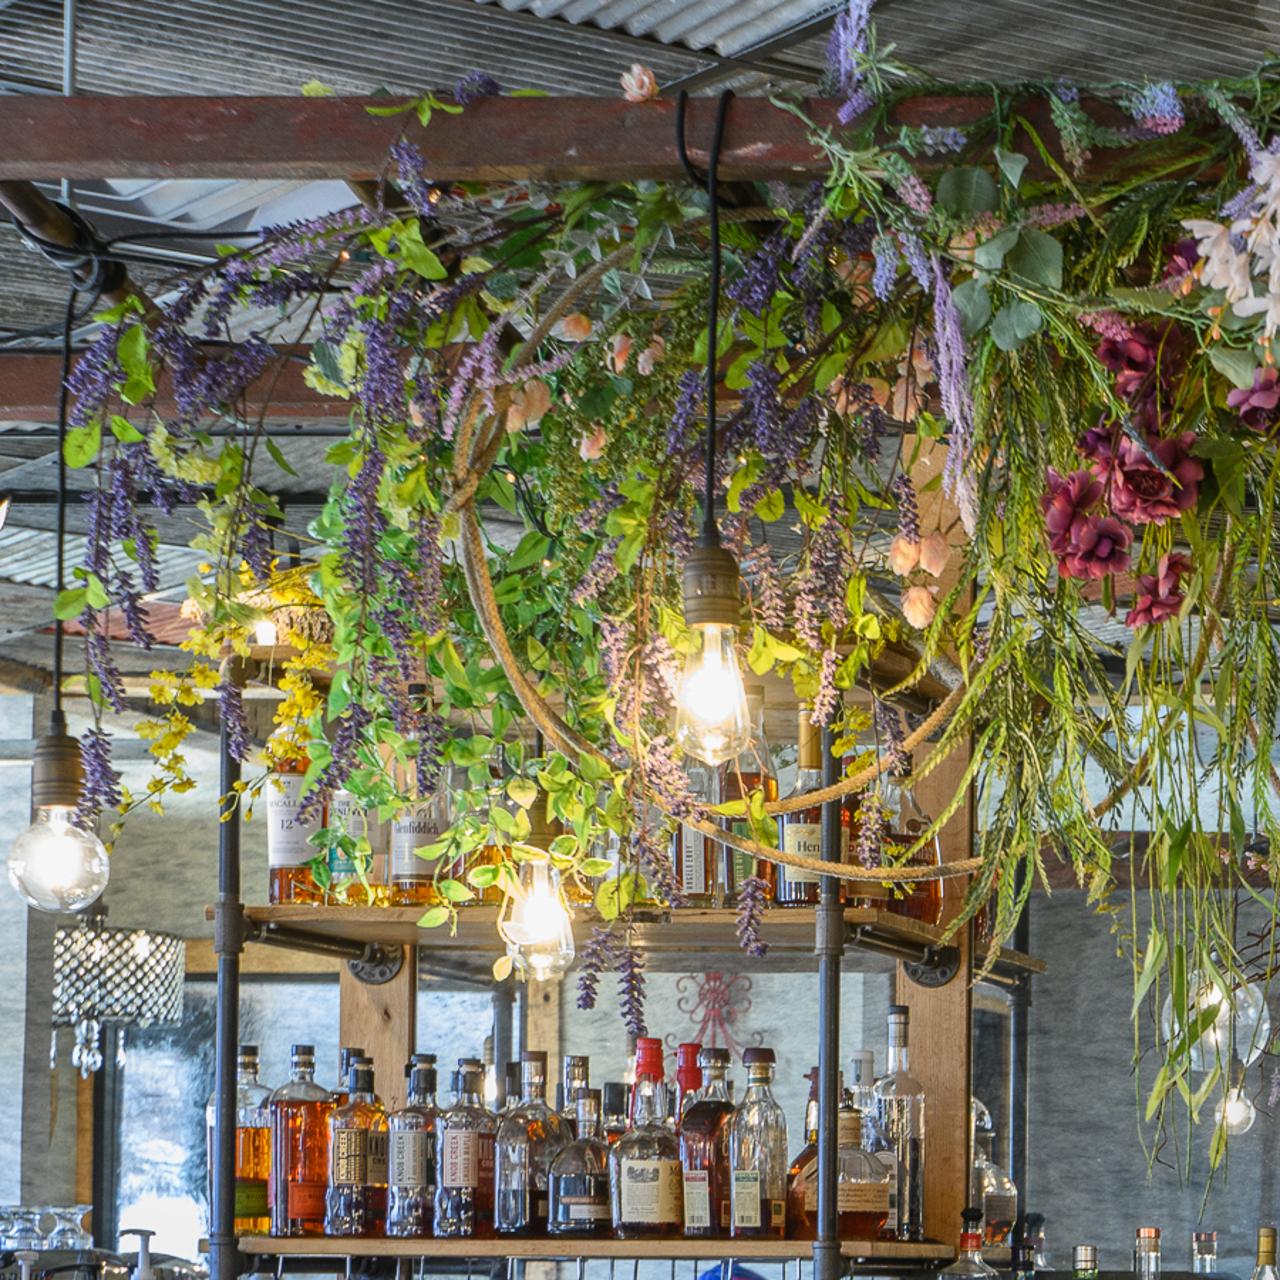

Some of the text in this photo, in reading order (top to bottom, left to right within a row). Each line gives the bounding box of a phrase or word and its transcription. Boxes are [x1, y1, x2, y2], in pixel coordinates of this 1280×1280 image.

[280, 819, 294, 831] 12
[393, 820, 439, 834] lenfiddich
[396, 1135, 404, 1182] KNOB CREEK
[450, 1135, 458, 1182] KNOB CREEK
